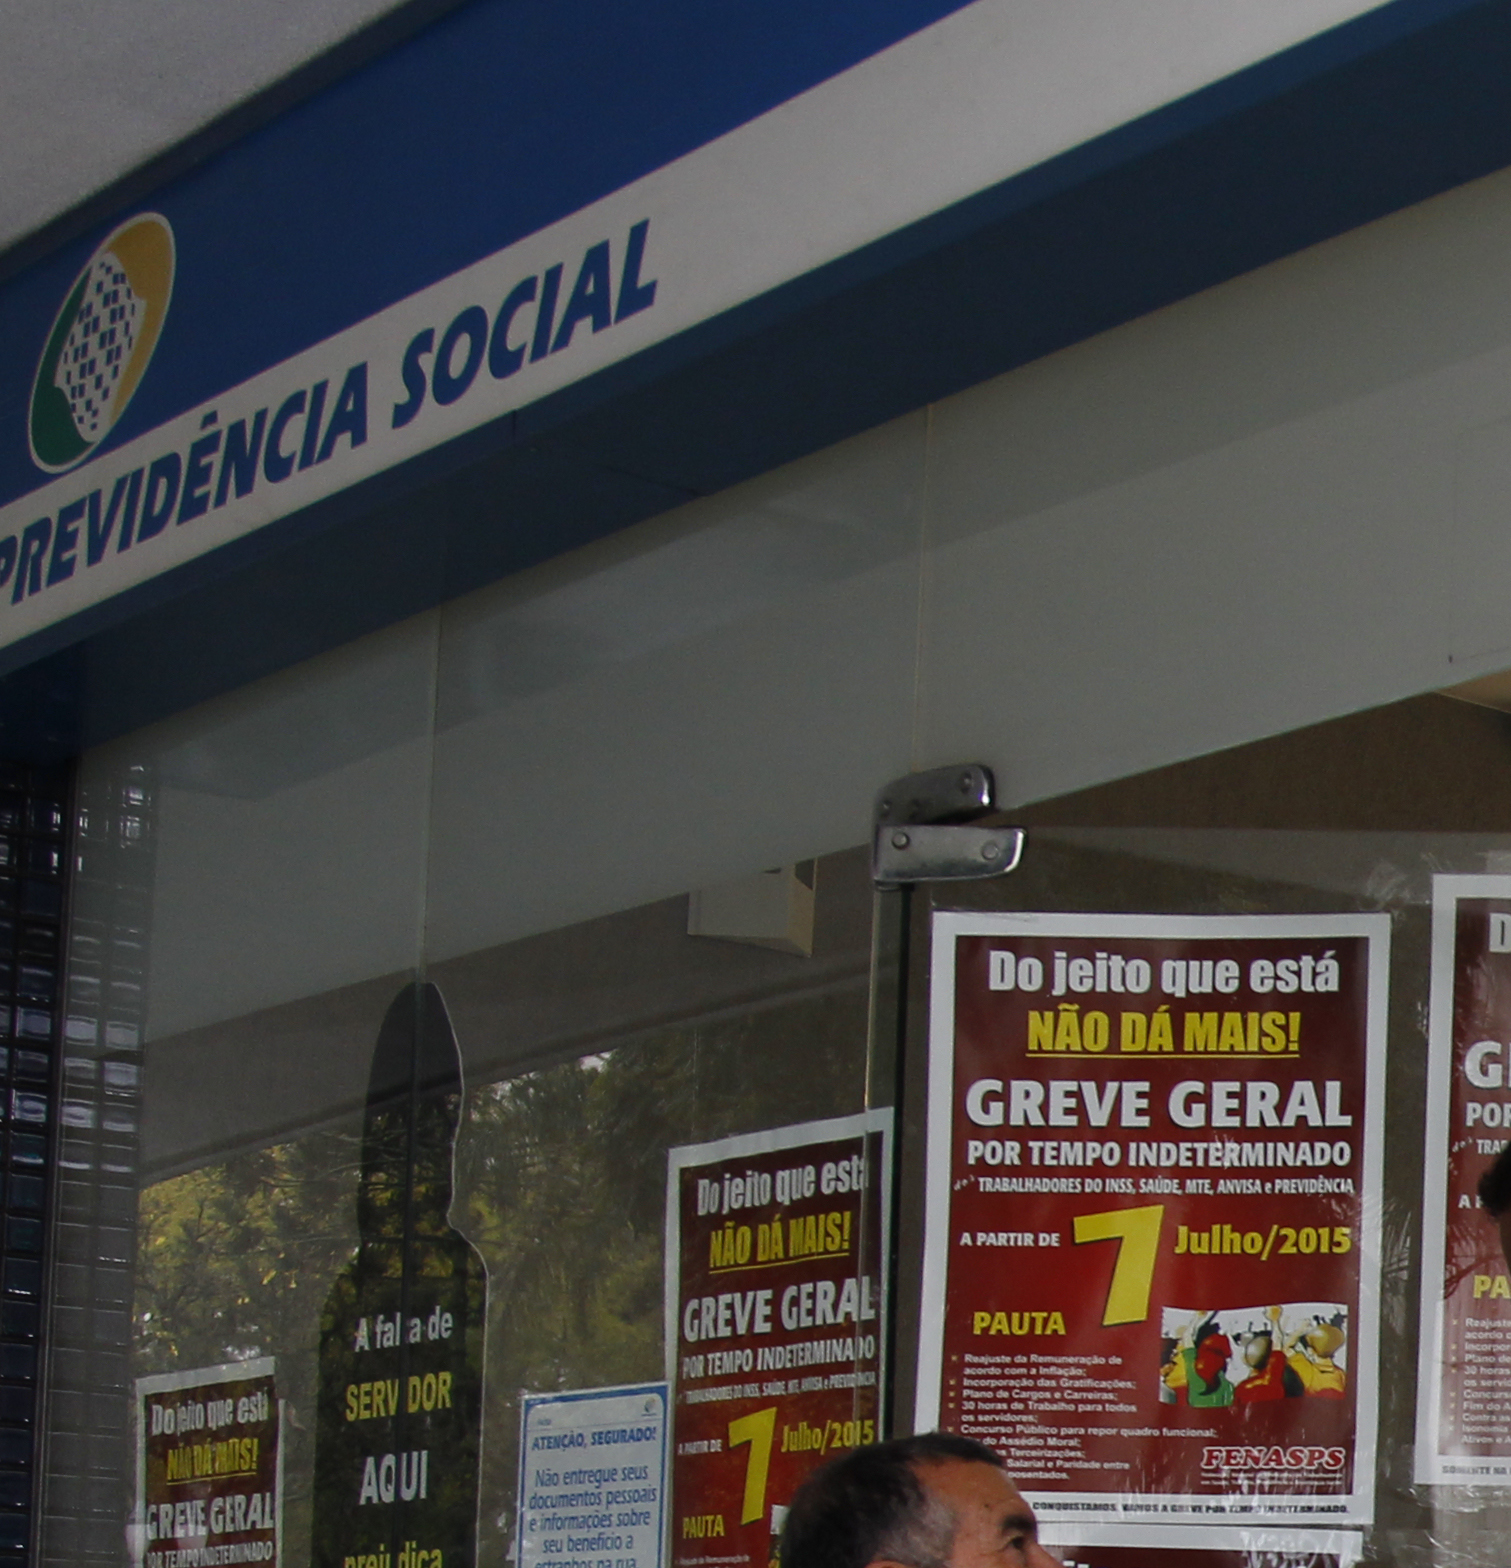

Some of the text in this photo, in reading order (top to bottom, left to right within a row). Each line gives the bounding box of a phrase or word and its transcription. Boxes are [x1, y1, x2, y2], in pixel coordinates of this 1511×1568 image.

[0, 218, 658, 602] PREVIDÊNCIA SOCIAL
[988, 950, 1339, 998] Do jeito que está
[1027, 1003, 1300, 1052] NÃO DÁ MAIS!
[965, 1078, 1352, 1128] GREVE GERAL
[967, 1141, 1351, 1167] POR TEMPO INDETERMINADO
[960, 1205, 1352, 1327] A PARTIR DE 7 Julho/2015
[973, 1312, 1065, 1335] PAUTA
[532, 1426, 656, 1453] ATENÇÃO, SEGURADO!
[1201, 1446, 1345, 1470] FENASPS
[535, 1466, 648, 1488] Não entregue seus
[529, 1486, 656, 1510] documentos pessoais
[529, 1508, 650, 1533] e informações sobre
[543, 1539, 563, 1553] seu
[626, 1536, 633, 1549] a
